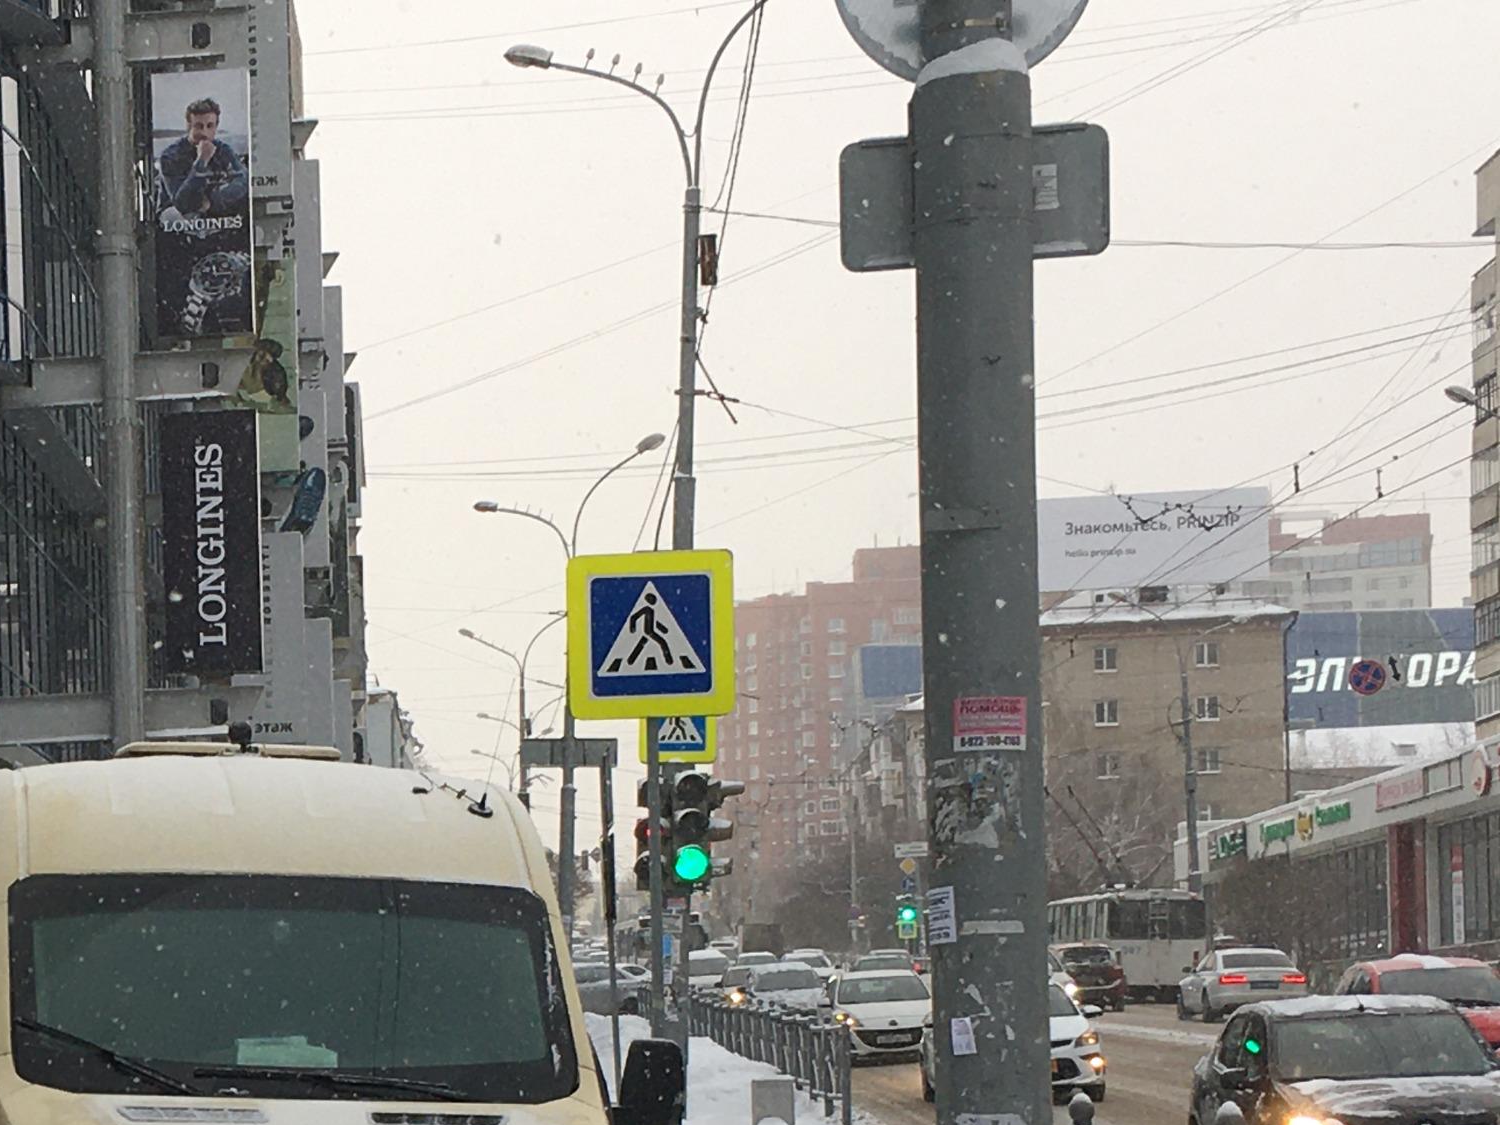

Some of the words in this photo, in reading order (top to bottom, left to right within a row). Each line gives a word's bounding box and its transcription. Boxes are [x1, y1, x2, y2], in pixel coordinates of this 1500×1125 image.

[163, 214, 243, 233] LONGINES
[1064, 520, 1171, 536] Знакомьтесь,
[1176, 514, 1241, 531] PRINZIP
[195, 442, 227, 647] LONGINES
[254, 722, 293, 735] этаж
